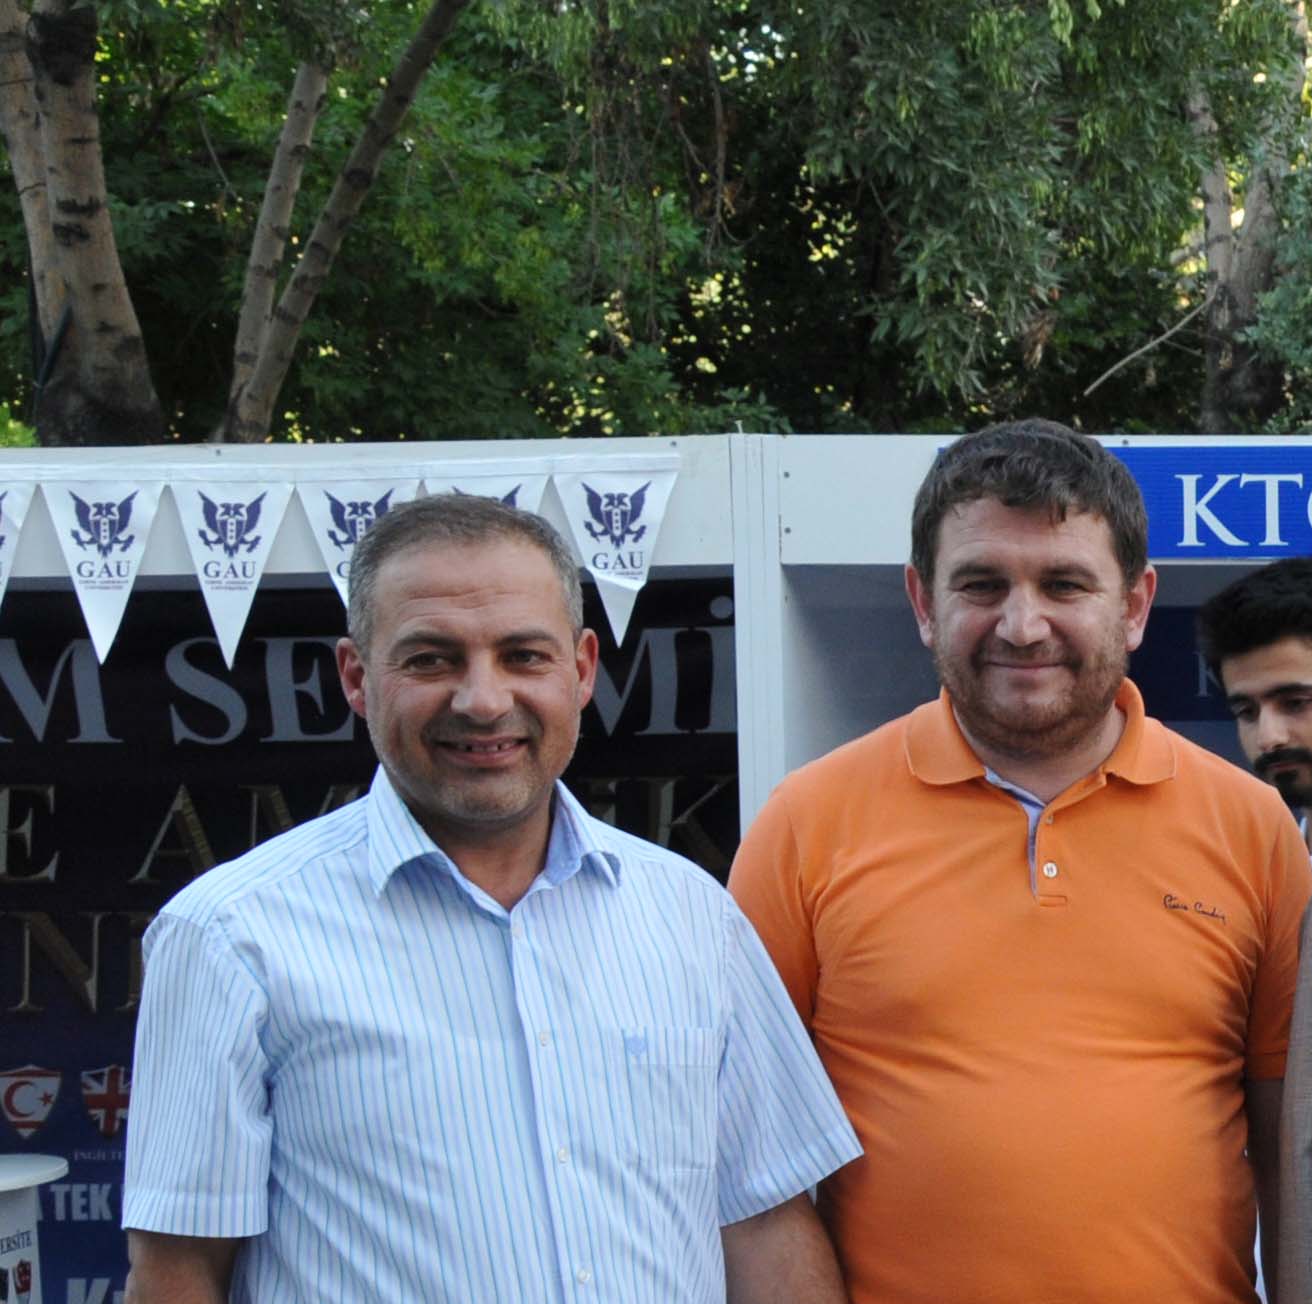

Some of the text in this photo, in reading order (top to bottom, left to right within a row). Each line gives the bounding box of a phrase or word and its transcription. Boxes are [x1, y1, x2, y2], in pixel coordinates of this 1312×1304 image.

[76, 560, 131, 578] GAU
[203, 560, 257, 578] GAU
[50, 1183, 113, 1221] TEK
